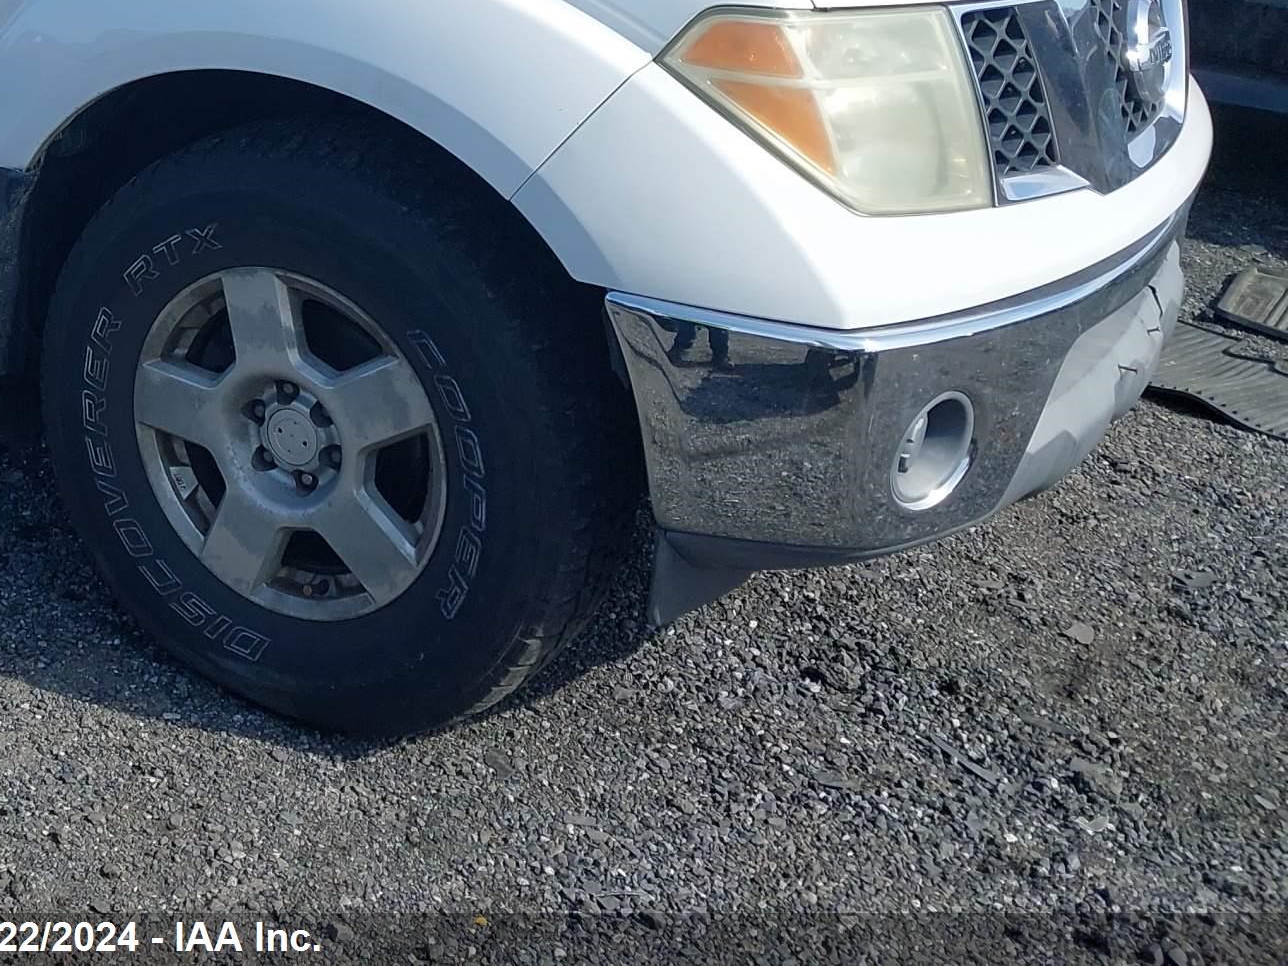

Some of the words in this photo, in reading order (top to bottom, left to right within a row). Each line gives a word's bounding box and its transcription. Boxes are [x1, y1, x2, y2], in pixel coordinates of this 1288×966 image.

[121, 222, 224, 298] RTX
[81, 306, 272, 663] DISCOVERER
[406, 329, 488, 620] COOPER
